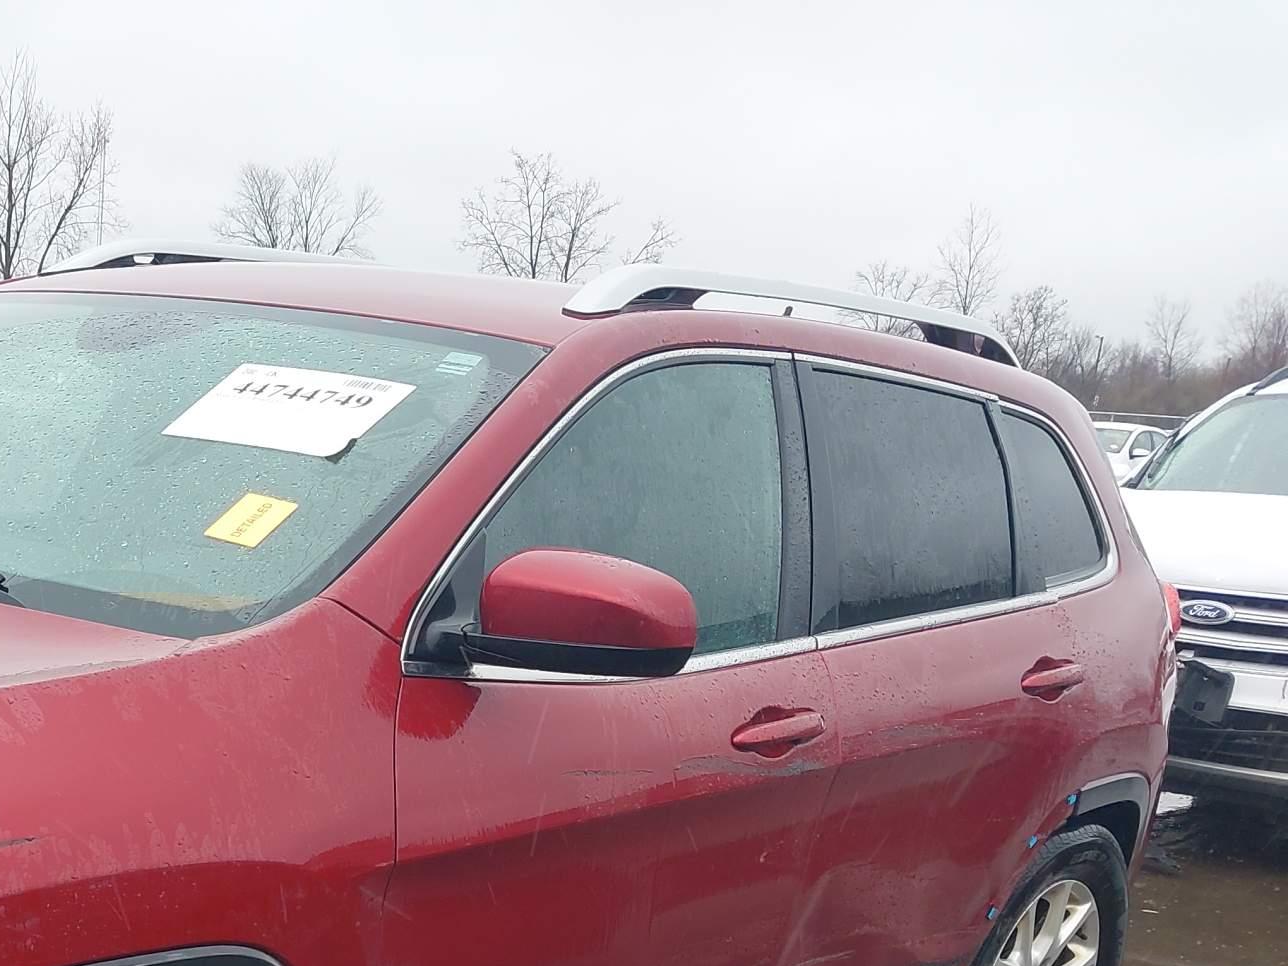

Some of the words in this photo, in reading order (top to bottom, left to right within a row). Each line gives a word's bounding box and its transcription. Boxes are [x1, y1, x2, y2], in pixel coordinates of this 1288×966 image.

[232, 381, 374, 409] 44744749
[230, 502, 273, 538] DETAILED
[1188, 603, 1221, 619] Ford
